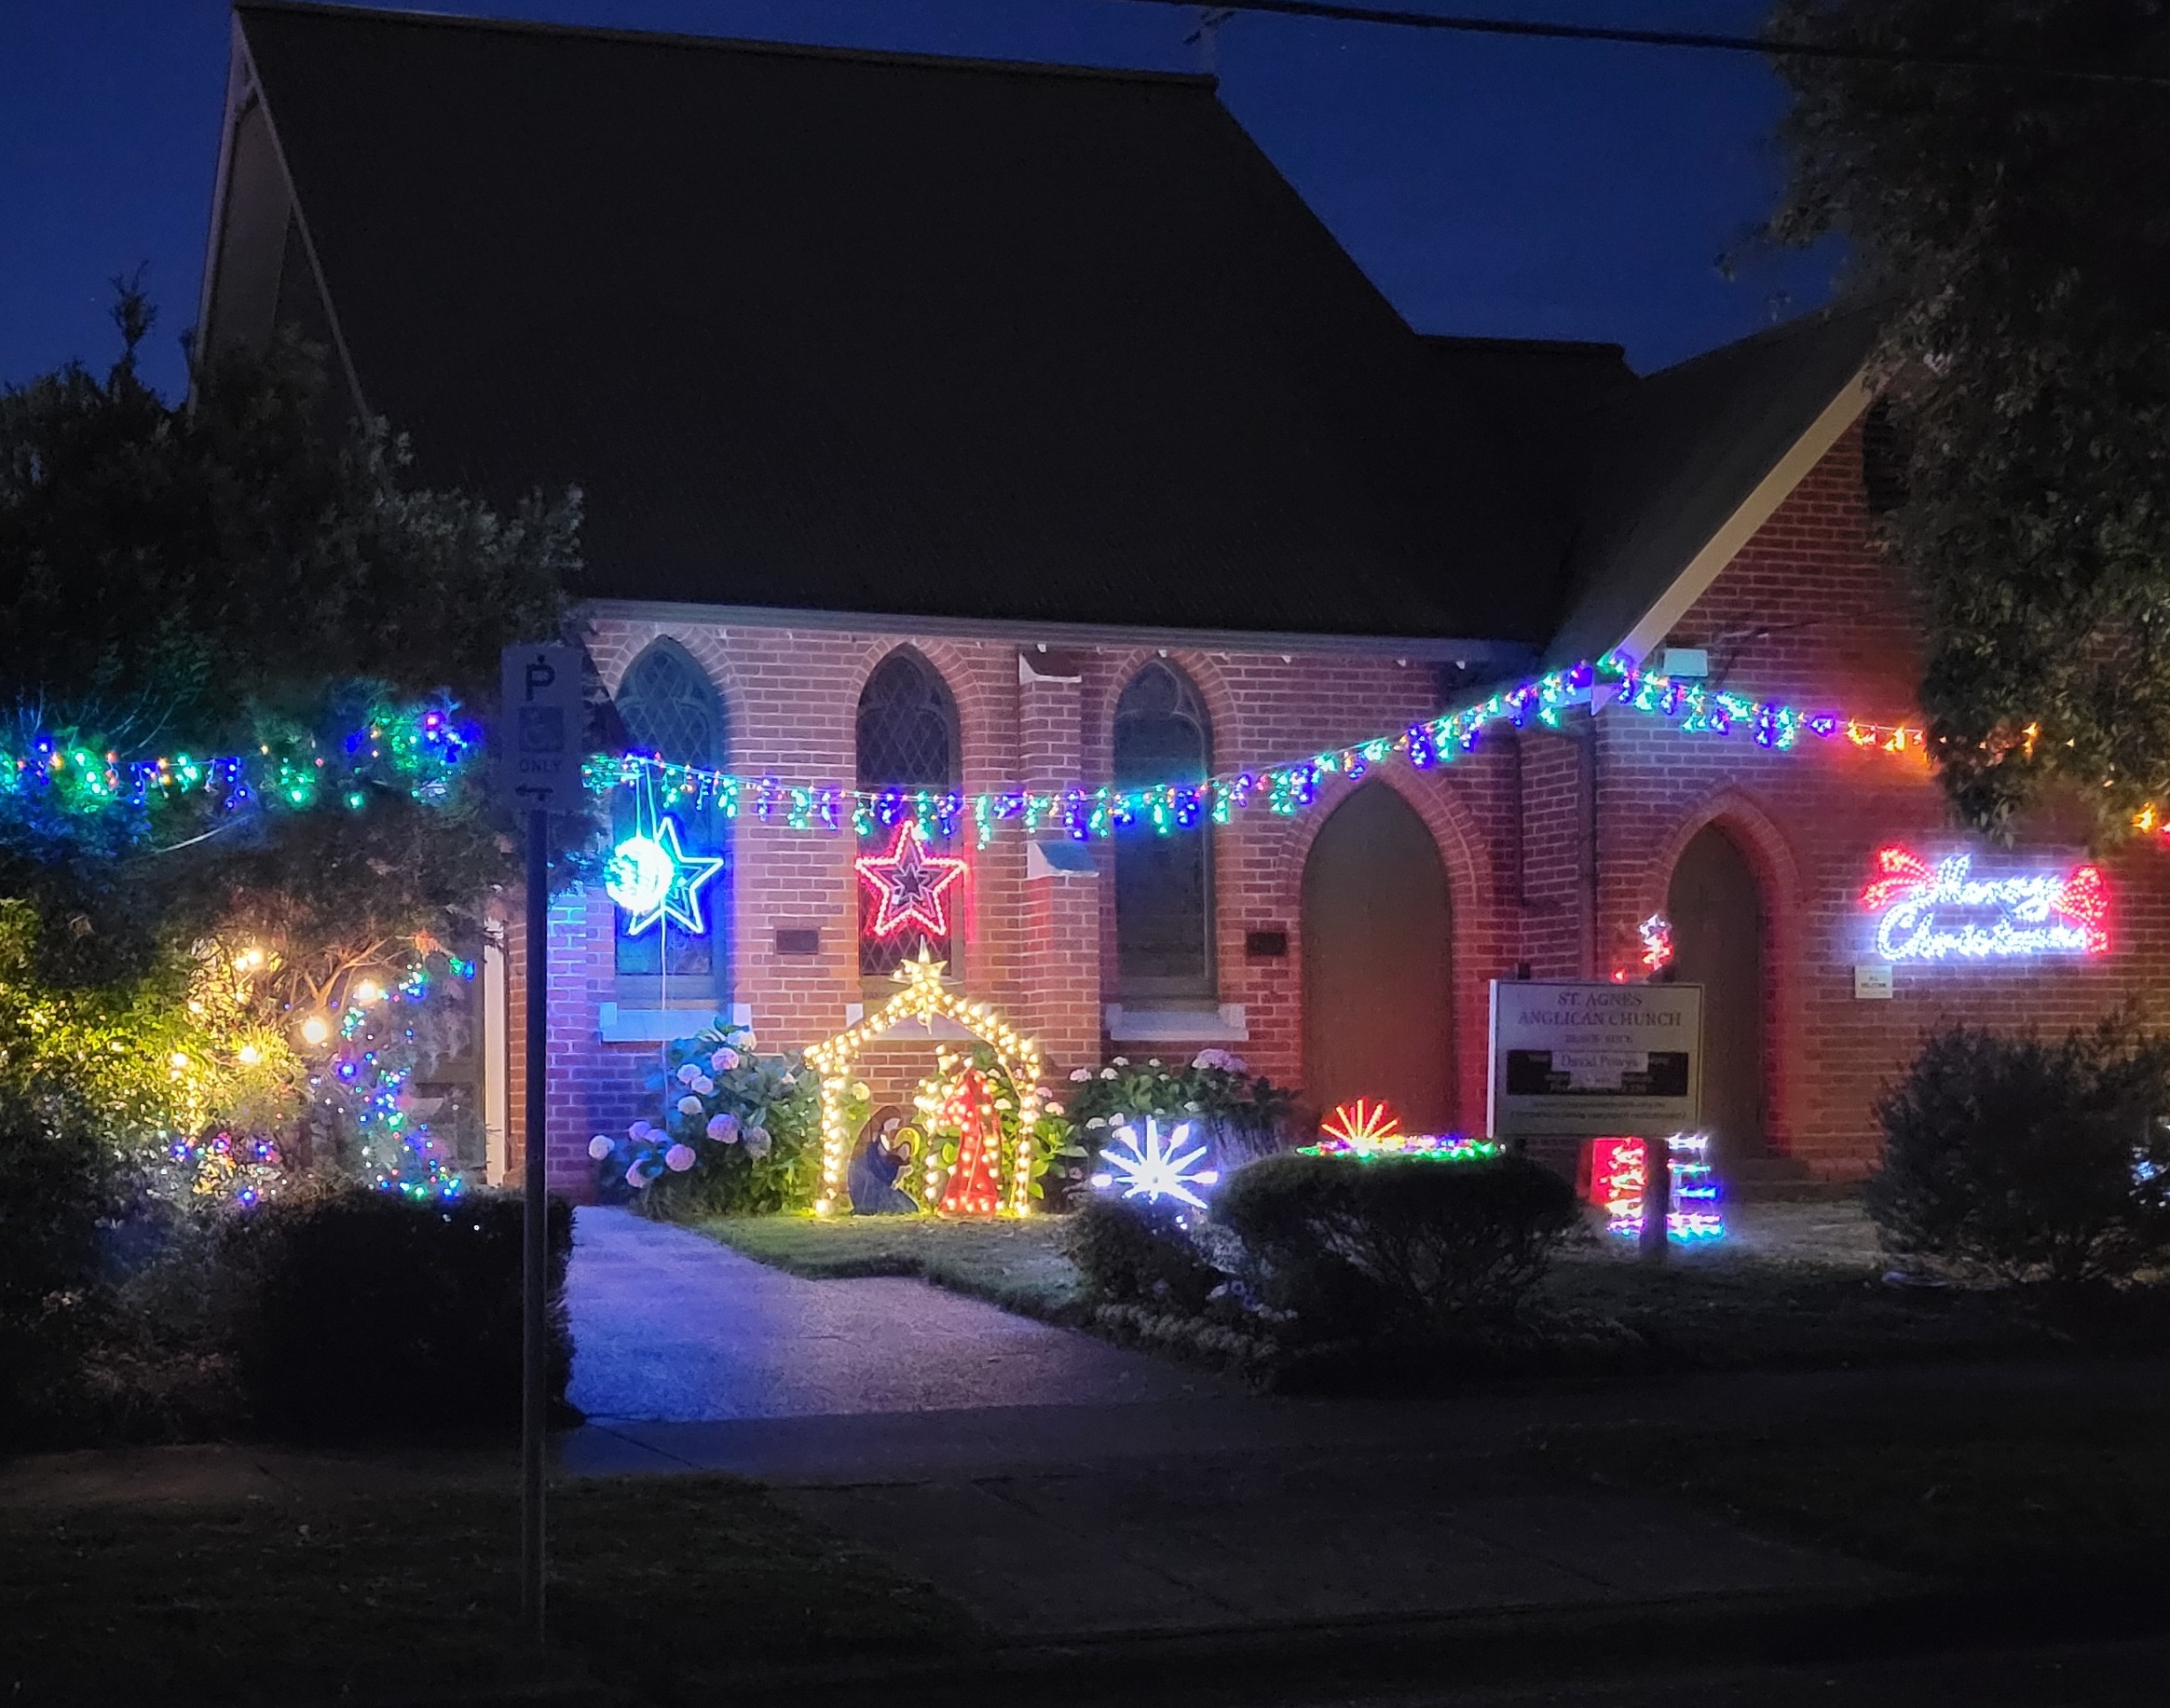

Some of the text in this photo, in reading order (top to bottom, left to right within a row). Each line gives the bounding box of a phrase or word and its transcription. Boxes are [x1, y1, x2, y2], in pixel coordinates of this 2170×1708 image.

[525, 663, 555, 702] P
[519, 758, 563, 772] ONLY
[1910, 854, 2064, 922] Merry
[1877, 904, 2086, 961] Christmas
[1557, 991, 1642, 1006] ST. AGNES
[1518, 1011, 1682, 1026] ANGLICAN CHURCH
